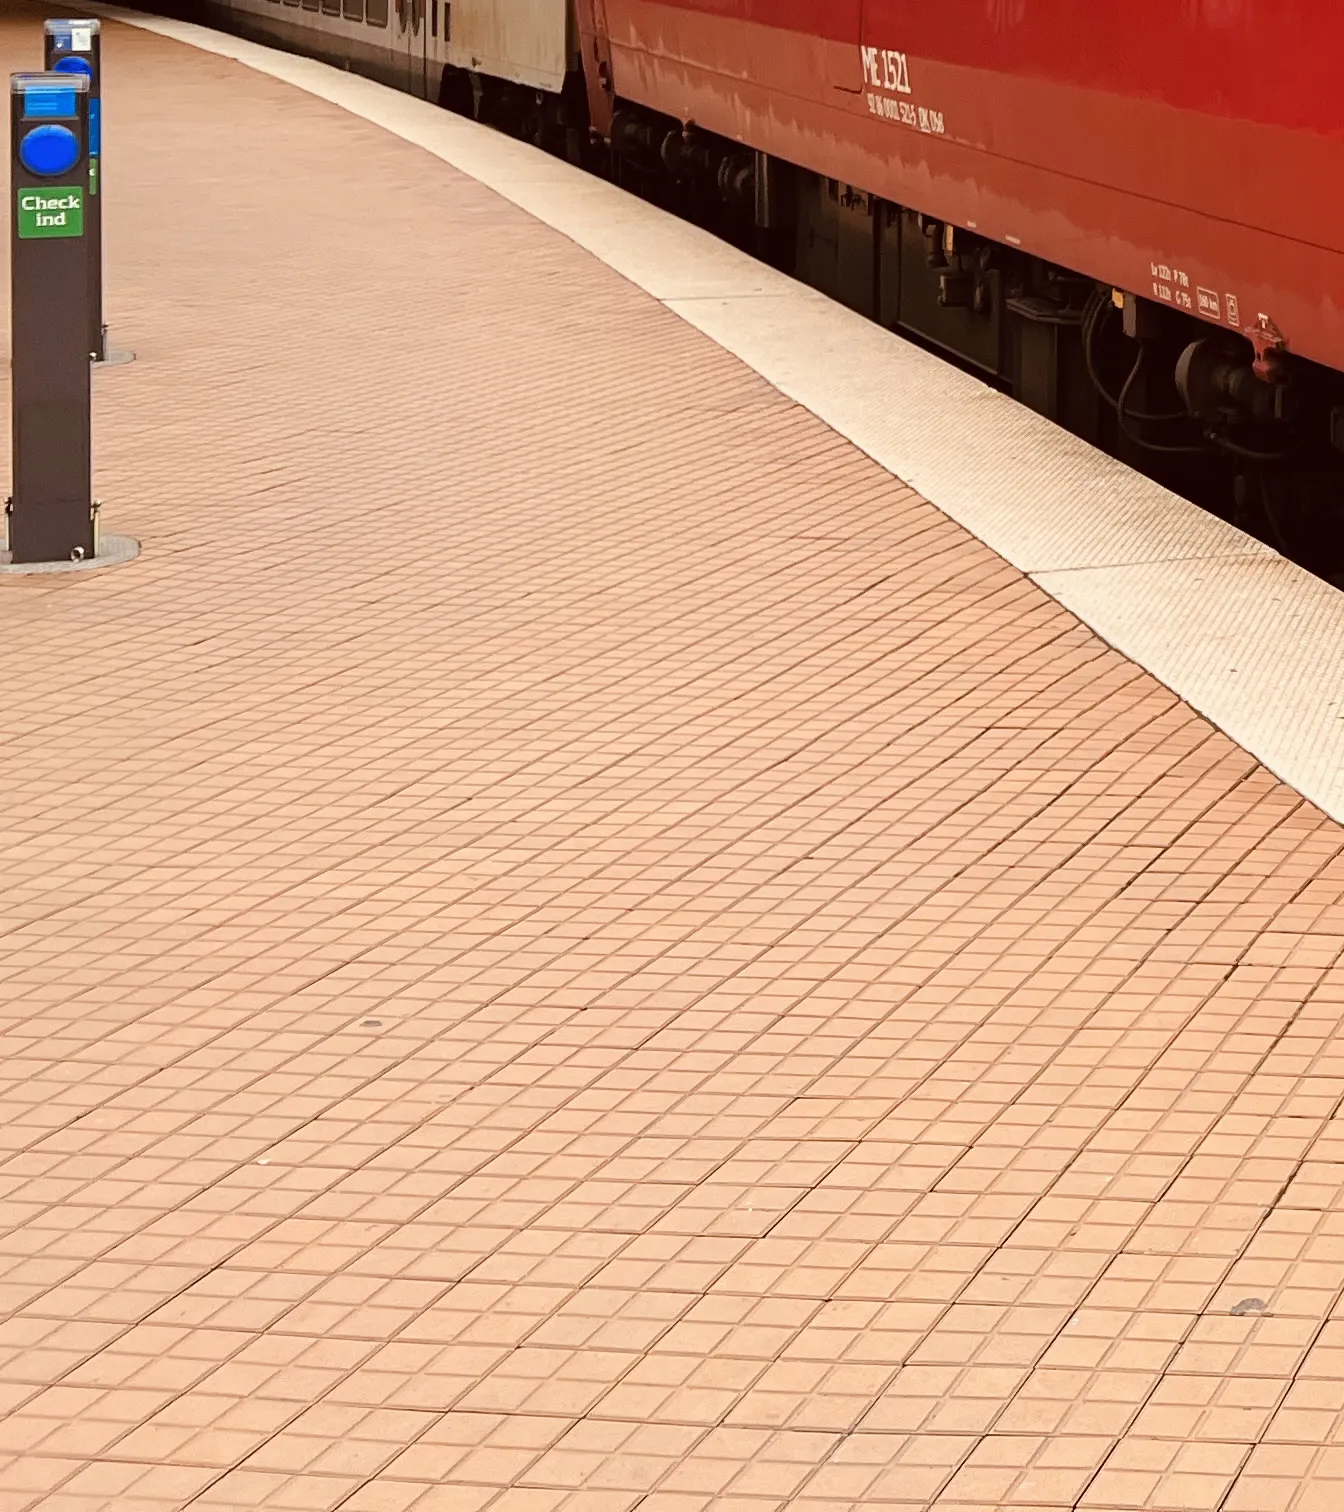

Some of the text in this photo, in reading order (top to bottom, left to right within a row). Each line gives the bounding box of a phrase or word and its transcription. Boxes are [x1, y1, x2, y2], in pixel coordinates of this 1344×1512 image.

[861, 45, 911, 94] ME 1521
[21, 194, 80, 211] Check
[35, 211, 66, 227] ind
